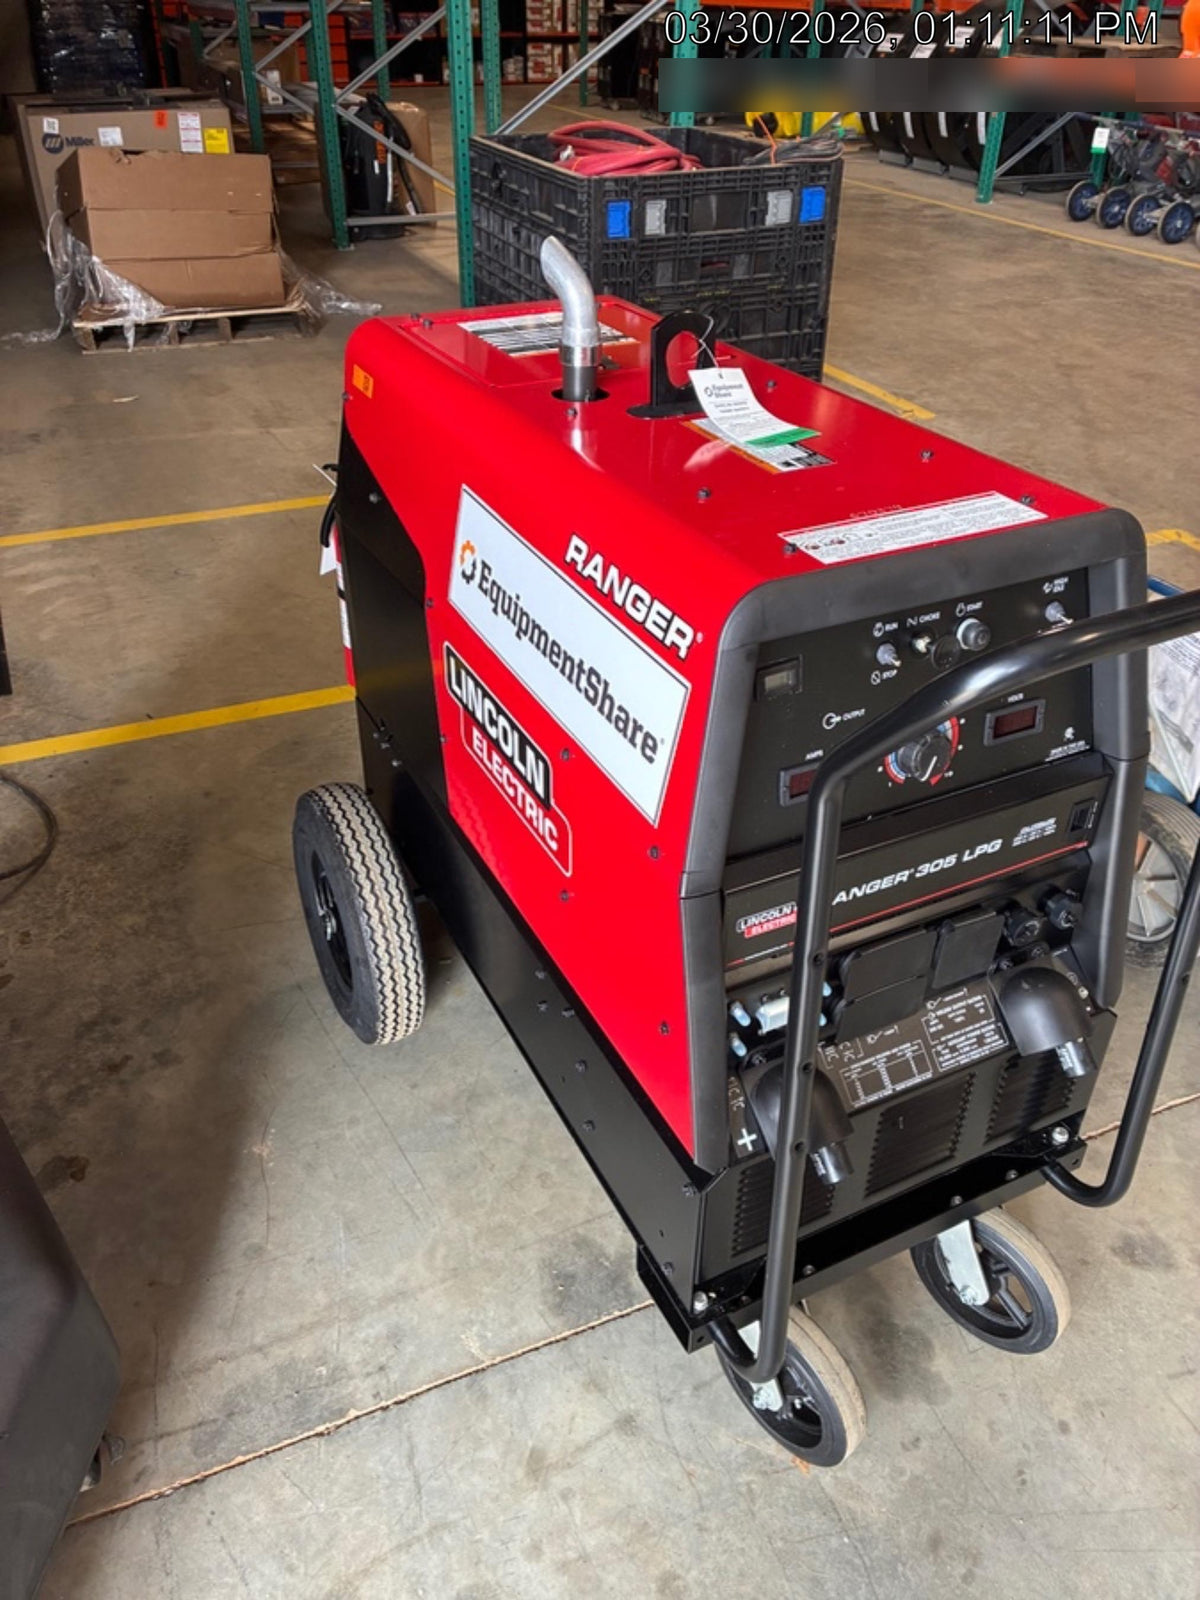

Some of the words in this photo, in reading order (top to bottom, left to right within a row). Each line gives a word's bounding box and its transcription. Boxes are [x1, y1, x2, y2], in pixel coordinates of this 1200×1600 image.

[65, 136, 94, 147] Miller
[564, 534, 697, 660] RANGER
[919, 611, 941, 623] CHOKE
[476, 559, 660, 766] EquipmentShare
[448, 655, 547, 801] LINCOLN
[471, 725, 560, 852] ELECTRIC
[915, 853, 958, 878] 305
[962, 838, 1004, 862] LPG
[740, 903, 791, 930] LINCOLN
